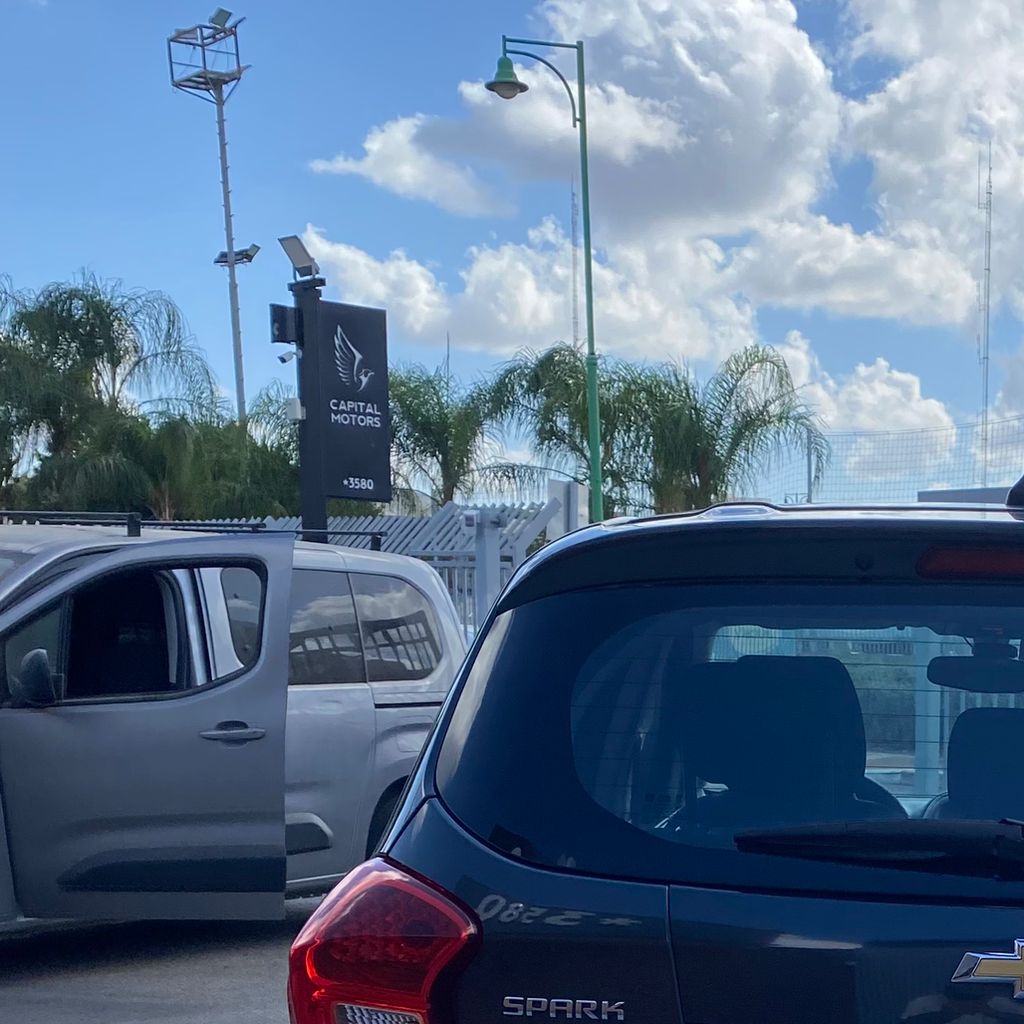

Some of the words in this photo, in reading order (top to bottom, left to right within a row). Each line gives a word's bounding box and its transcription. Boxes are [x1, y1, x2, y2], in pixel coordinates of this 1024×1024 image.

[329, 399, 382, 416] CAPITAL
[331, 412, 381, 428] MOTORS
[502, 996, 625, 1021] SPARK
